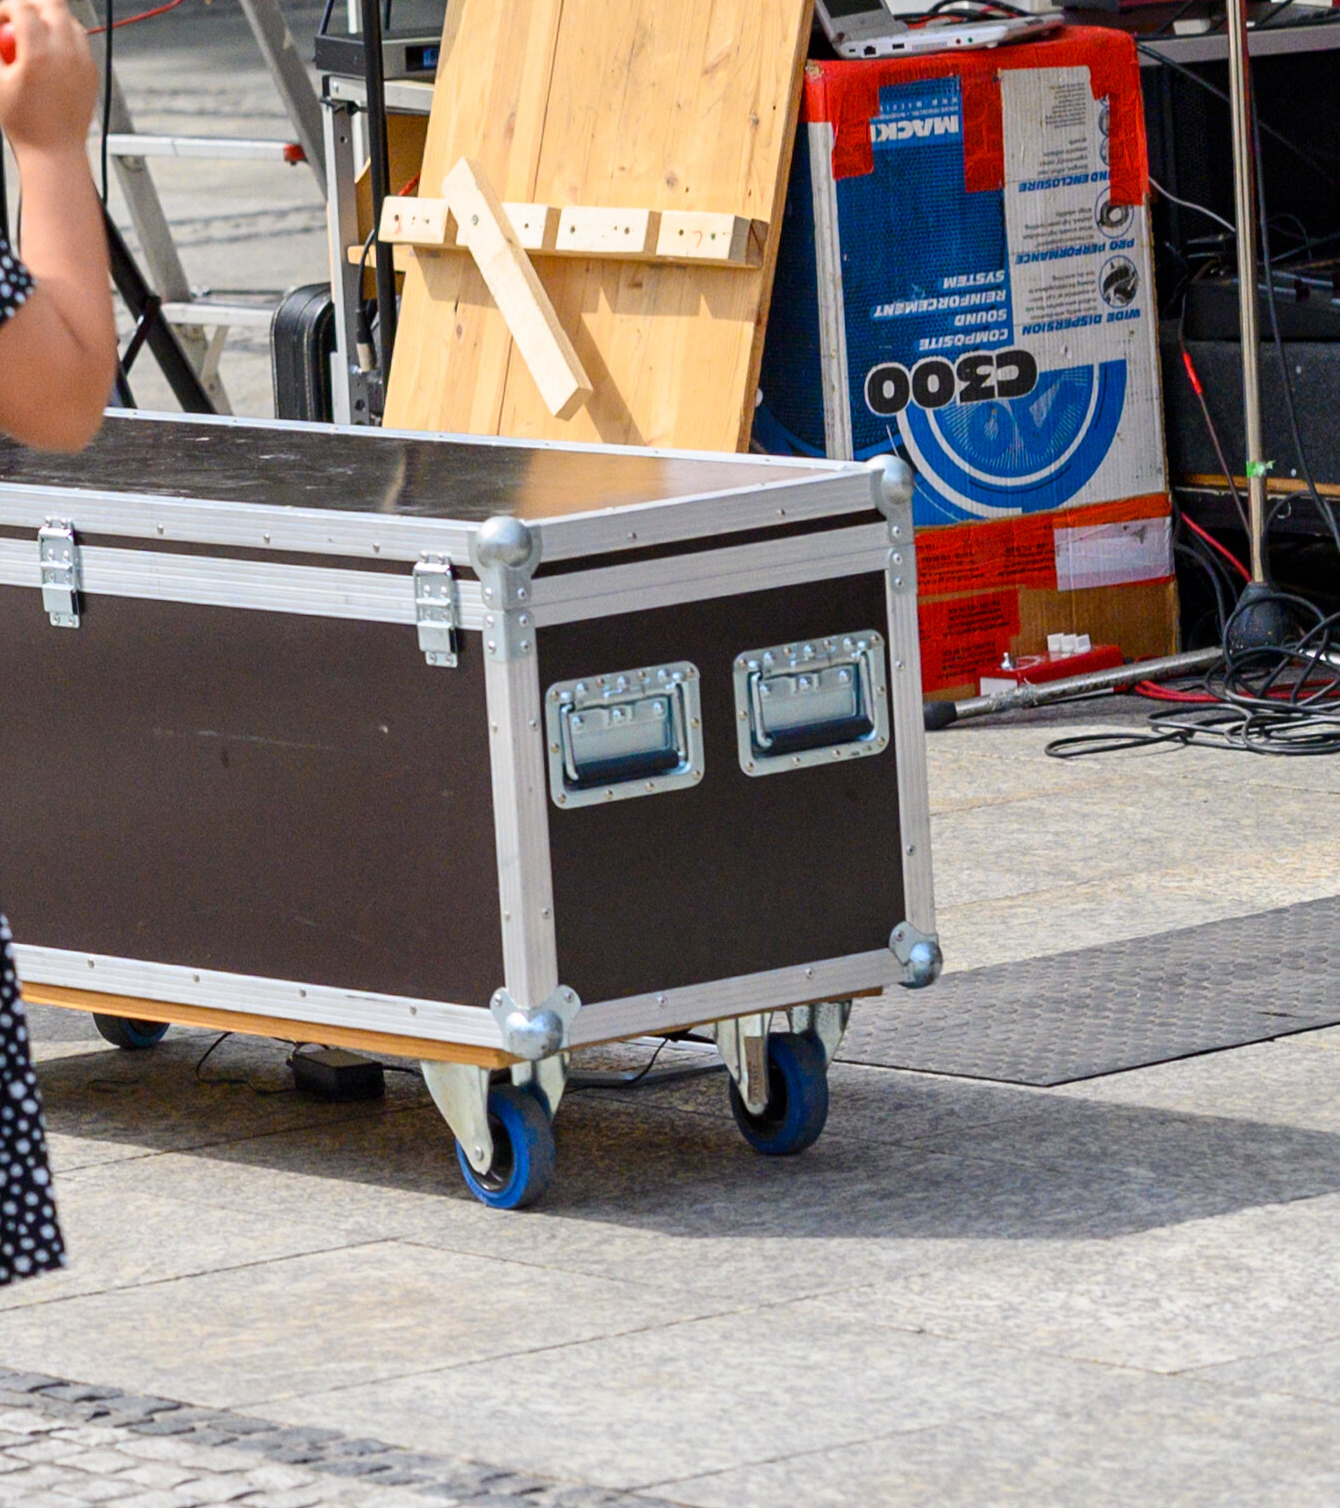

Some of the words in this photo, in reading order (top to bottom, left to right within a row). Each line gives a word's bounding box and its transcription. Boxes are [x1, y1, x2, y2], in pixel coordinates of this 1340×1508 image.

[870, 114, 959, 142] MACKI
[1018, 172, 1089, 192] ENCLOSURE
[1015, 242, 1106, 265] PERFORMANCE
[1109, 238, 1135, 251] PRO
[943, 270, 1005, 289] SYSTEM
[874, 290, 1007, 317] REINFORCEMENT
[954, 309, 1008, 326] SOUND
[1022, 314, 1102, 336] DISPERSION
[1106, 308, 1140, 323] WIDE
[919, 329, 1009, 351] COMPOSITE
[865, 347, 1038, 416] C300
